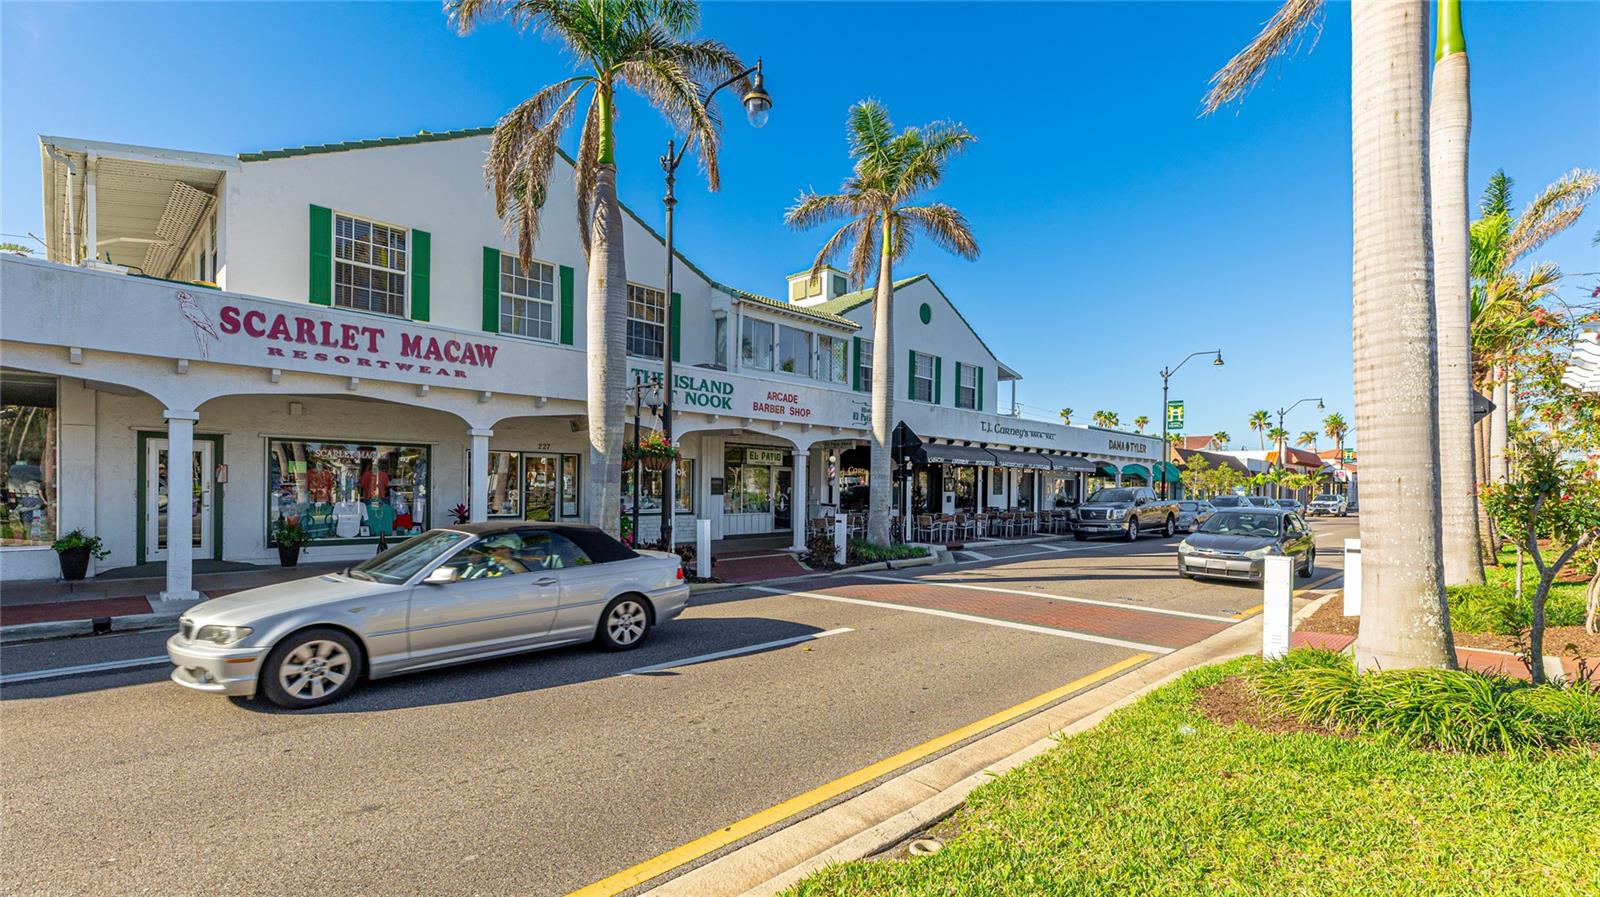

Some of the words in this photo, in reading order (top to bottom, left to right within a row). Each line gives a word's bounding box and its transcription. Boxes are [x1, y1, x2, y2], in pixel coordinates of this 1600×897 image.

[219, 305, 384, 353] SCARLET
[400, 332, 498, 368] MACAW
[267, 346, 468, 379] RESORTWEAR
[674, 374, 734, 395] ISLAND
[685, 391, 732, 410] NOOK
[766, 391, 798, 404] ARCADE
[752, 401, 786, 416] BARBER
[789, 405, 812, 418] SHOP
[314, 448, 355, 459] SCARLET
[1108, 439, 1125, 451] DANA
[1130, 442, 1147, 454] TYLER
[749, 451, 759, 460] EL
[761, 451, 782, 462] PATIO
